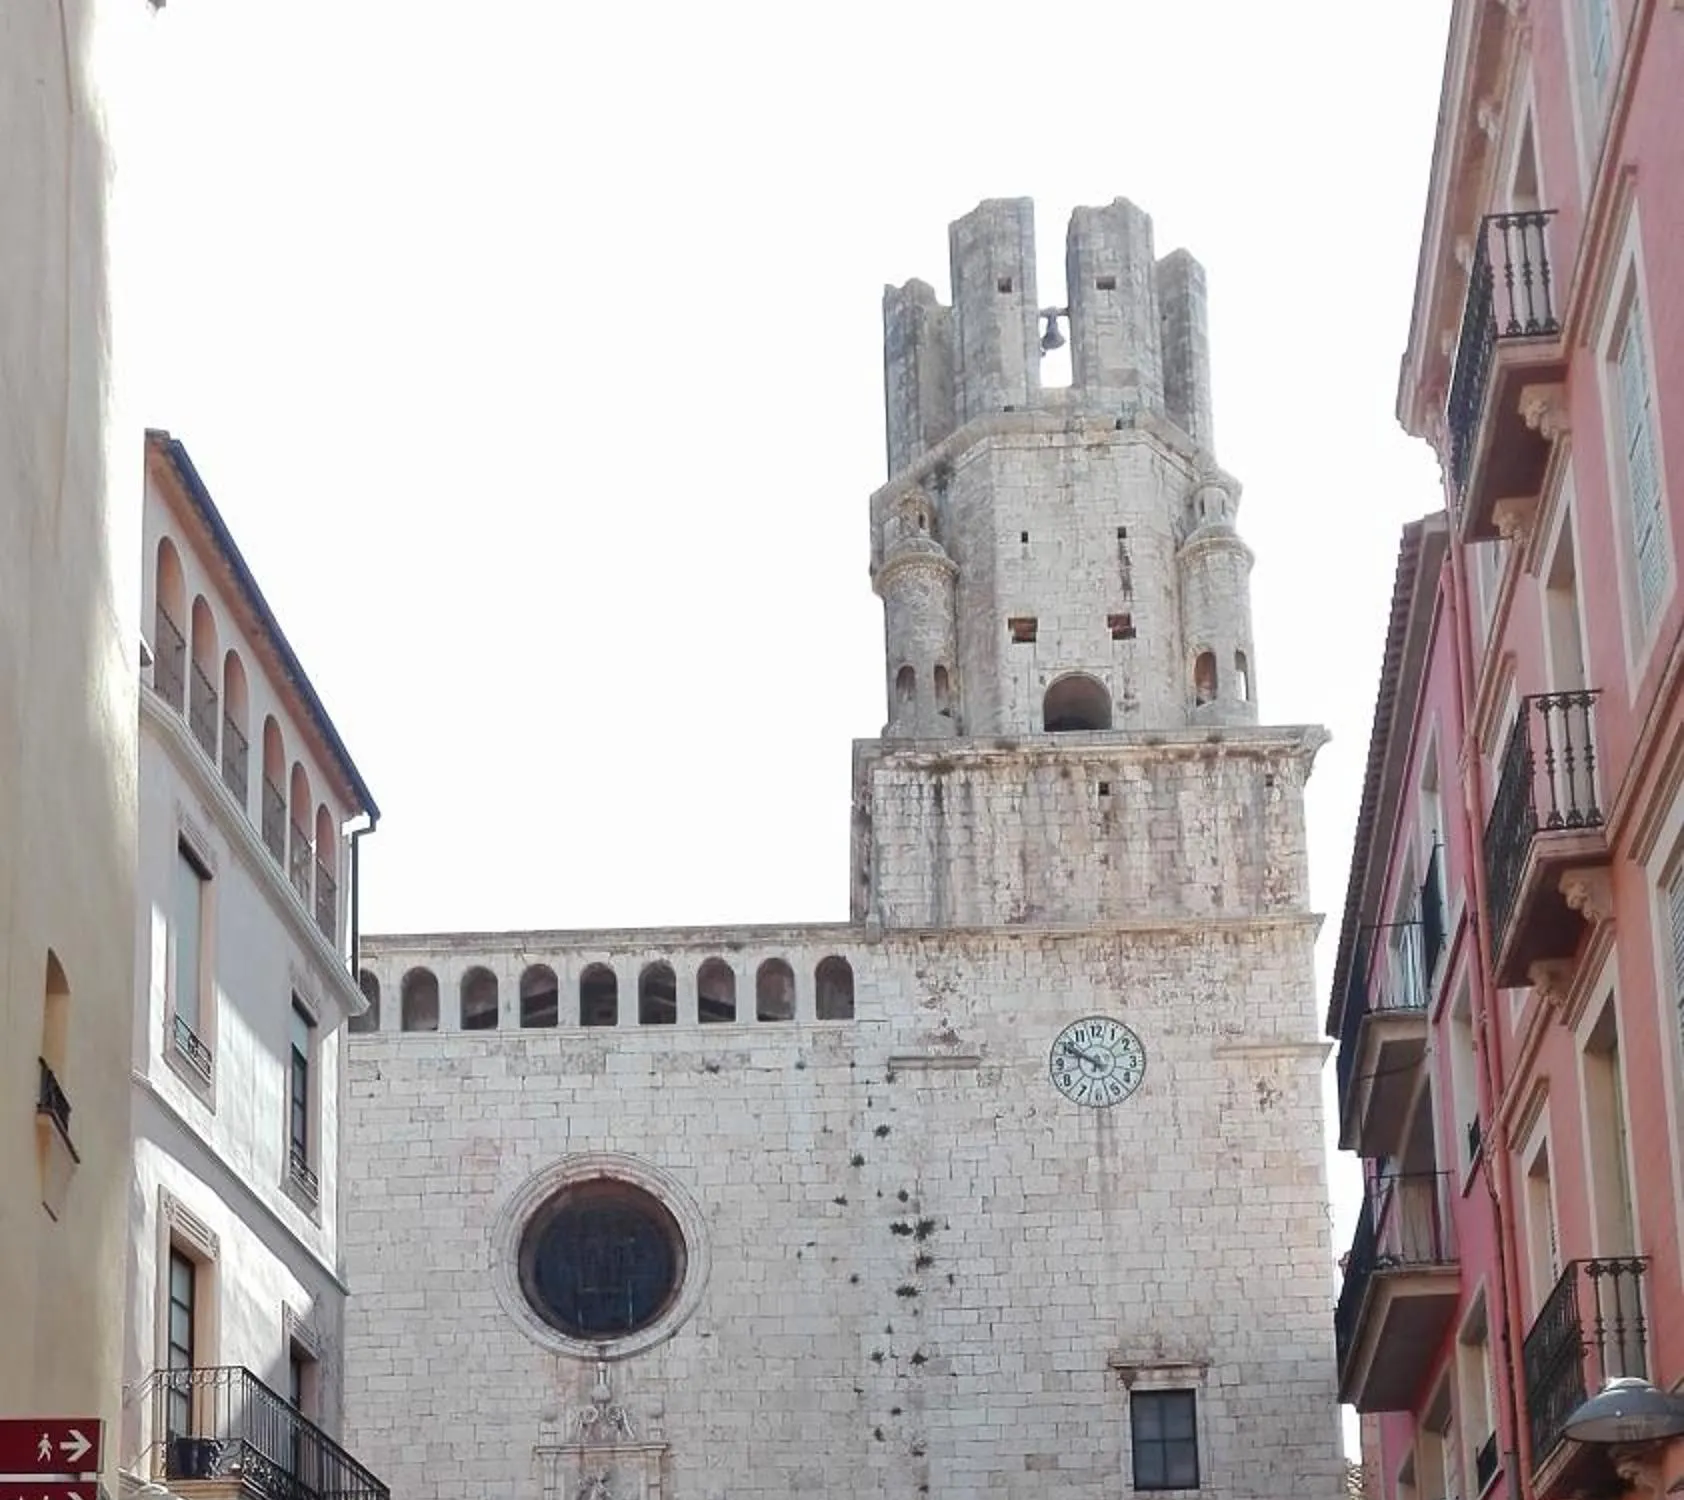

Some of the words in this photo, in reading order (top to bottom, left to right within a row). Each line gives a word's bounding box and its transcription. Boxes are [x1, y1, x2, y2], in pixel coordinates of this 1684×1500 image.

[1075, 1030, 1085, 1042] 11
[1090, 1025, 1102, 1038] 12
[1111, 1028, 1115, 1041] 1
[1121, 1038, 1130, 1051] 2
[1056, 1058, 1065, 1070] 9
[1129, 1055, 1137, 1068] 3
[1078, 1085, 1087, 1097] 7
[1110, 1083, 1121, 1095] 5
